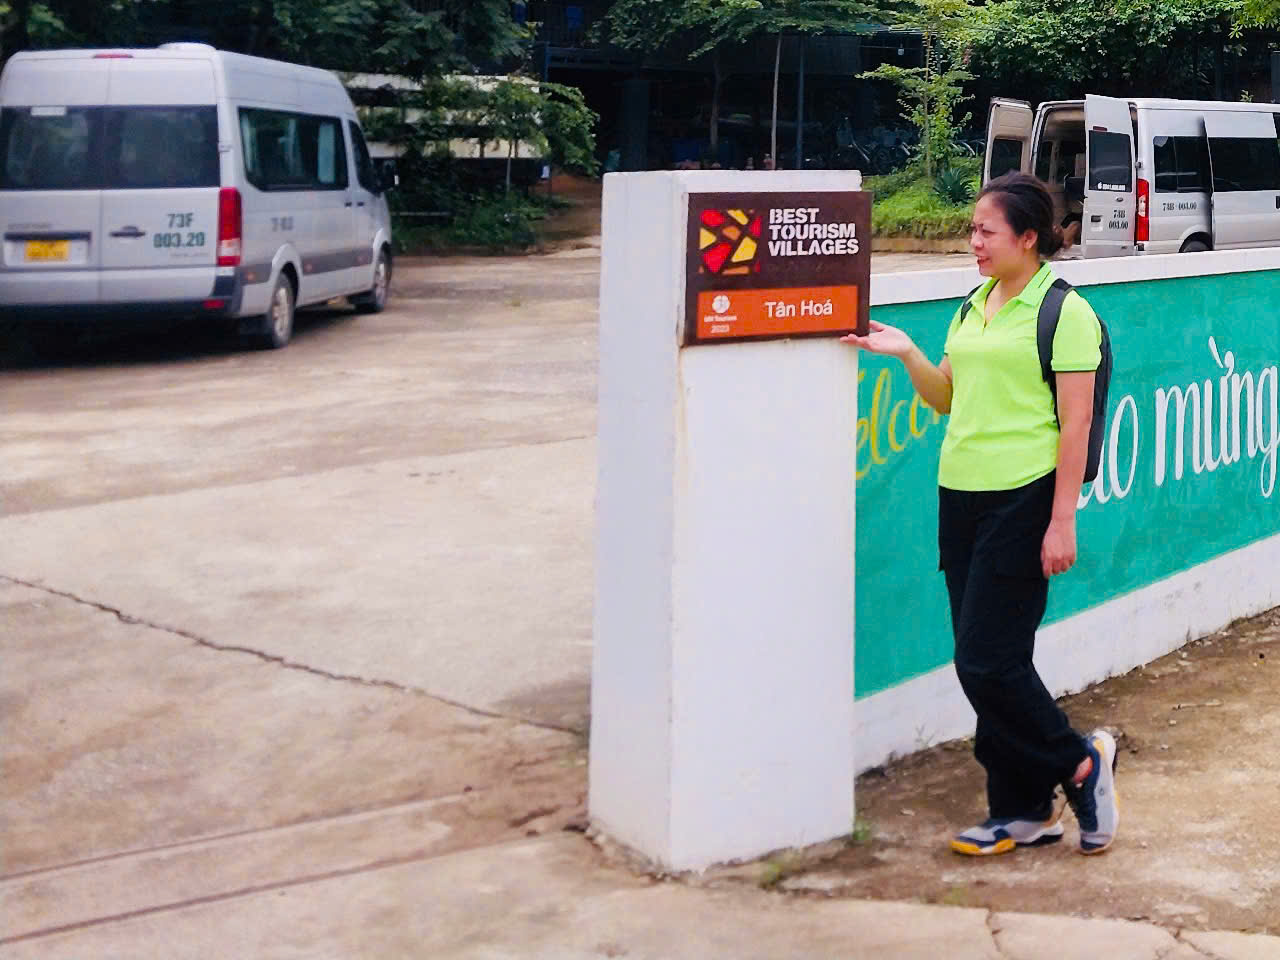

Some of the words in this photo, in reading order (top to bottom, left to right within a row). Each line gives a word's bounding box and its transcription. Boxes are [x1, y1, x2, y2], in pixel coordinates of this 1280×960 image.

[769, 208, 819, 224] BEST
[769, 223, 856, 241] TOURISM
[768, 239, 860, 257] VILLAGES
[764, 301, 796, 318] Tân
[801, 298, 833, 316] Hoá
